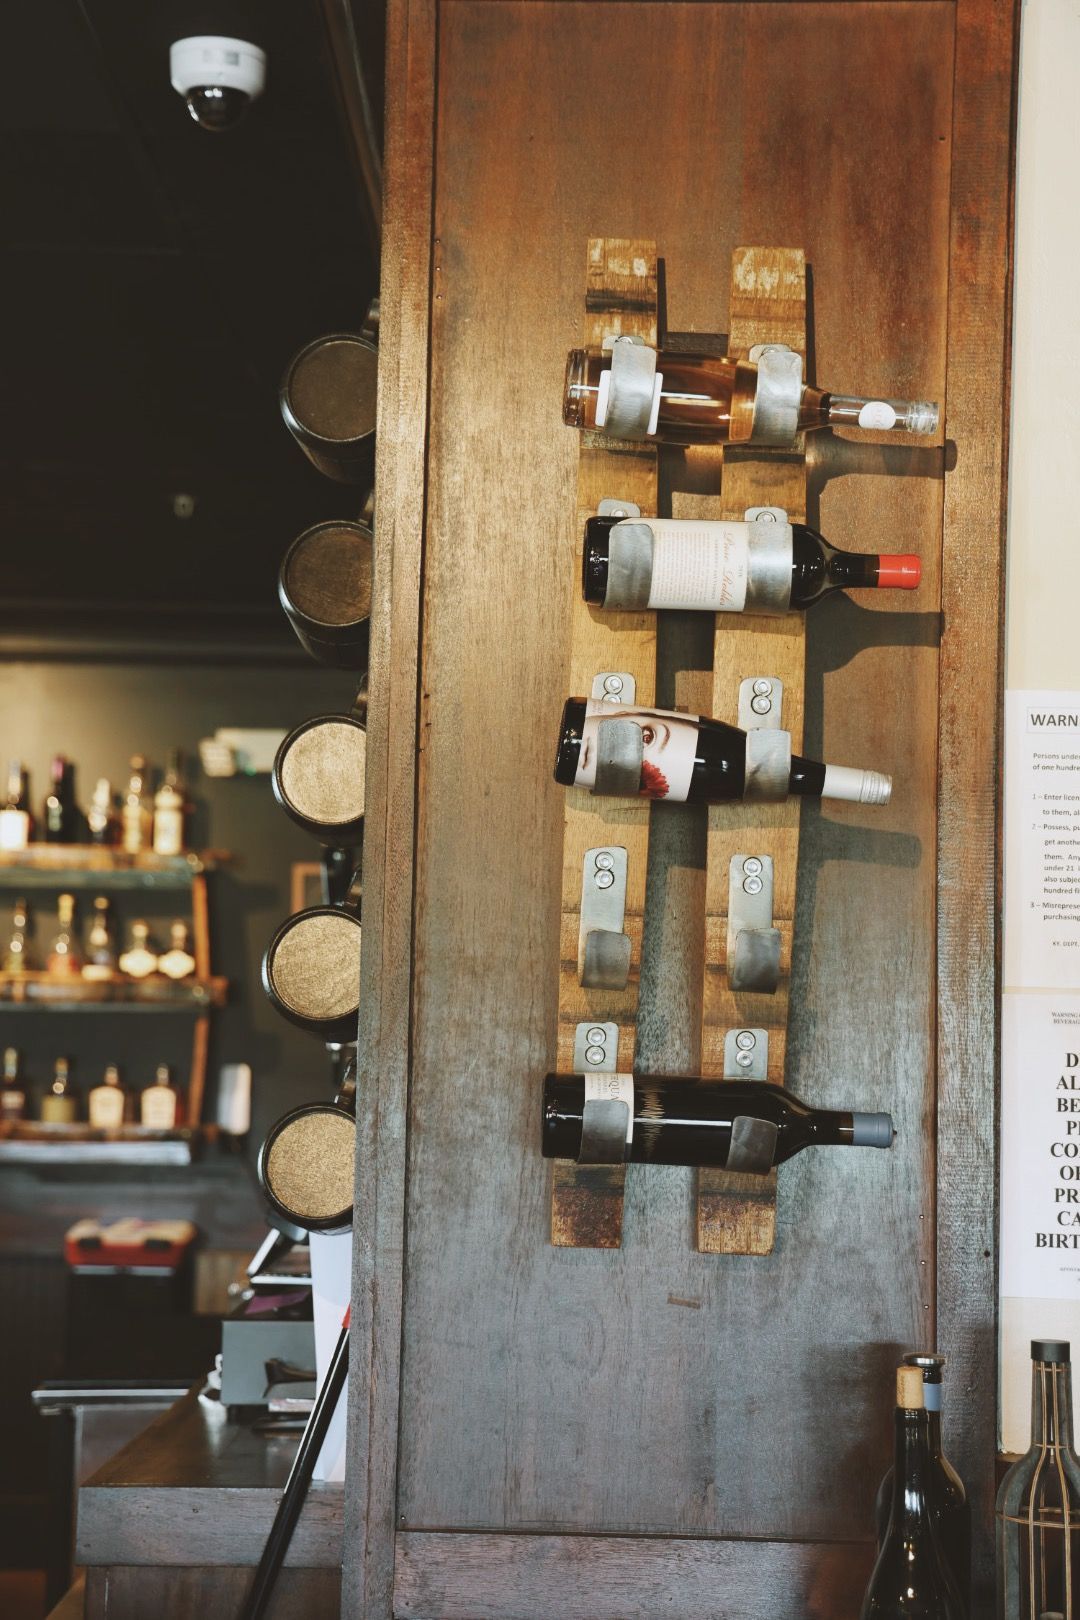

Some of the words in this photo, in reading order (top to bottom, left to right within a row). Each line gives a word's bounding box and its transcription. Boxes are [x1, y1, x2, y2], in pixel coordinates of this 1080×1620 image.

[1030, 713, 1079, 727] WARN
[1032, 752, 1059, 760] Persons
[1032, 763, 1039, 771] of
[1043, 793, 1062, 801] Enter
[1052, 808, 1071, 817] them,
[1043, 824, 1071, 832] Possess,
[1044, 839, 1055, 847] get
[1065, 1052, 1080, 1068] D
[1056, 1098, 1080, 1113] BE
[1050, 1142, 1080, 1159] CO
[1035, 1232, 1080, 1249] BIRT
